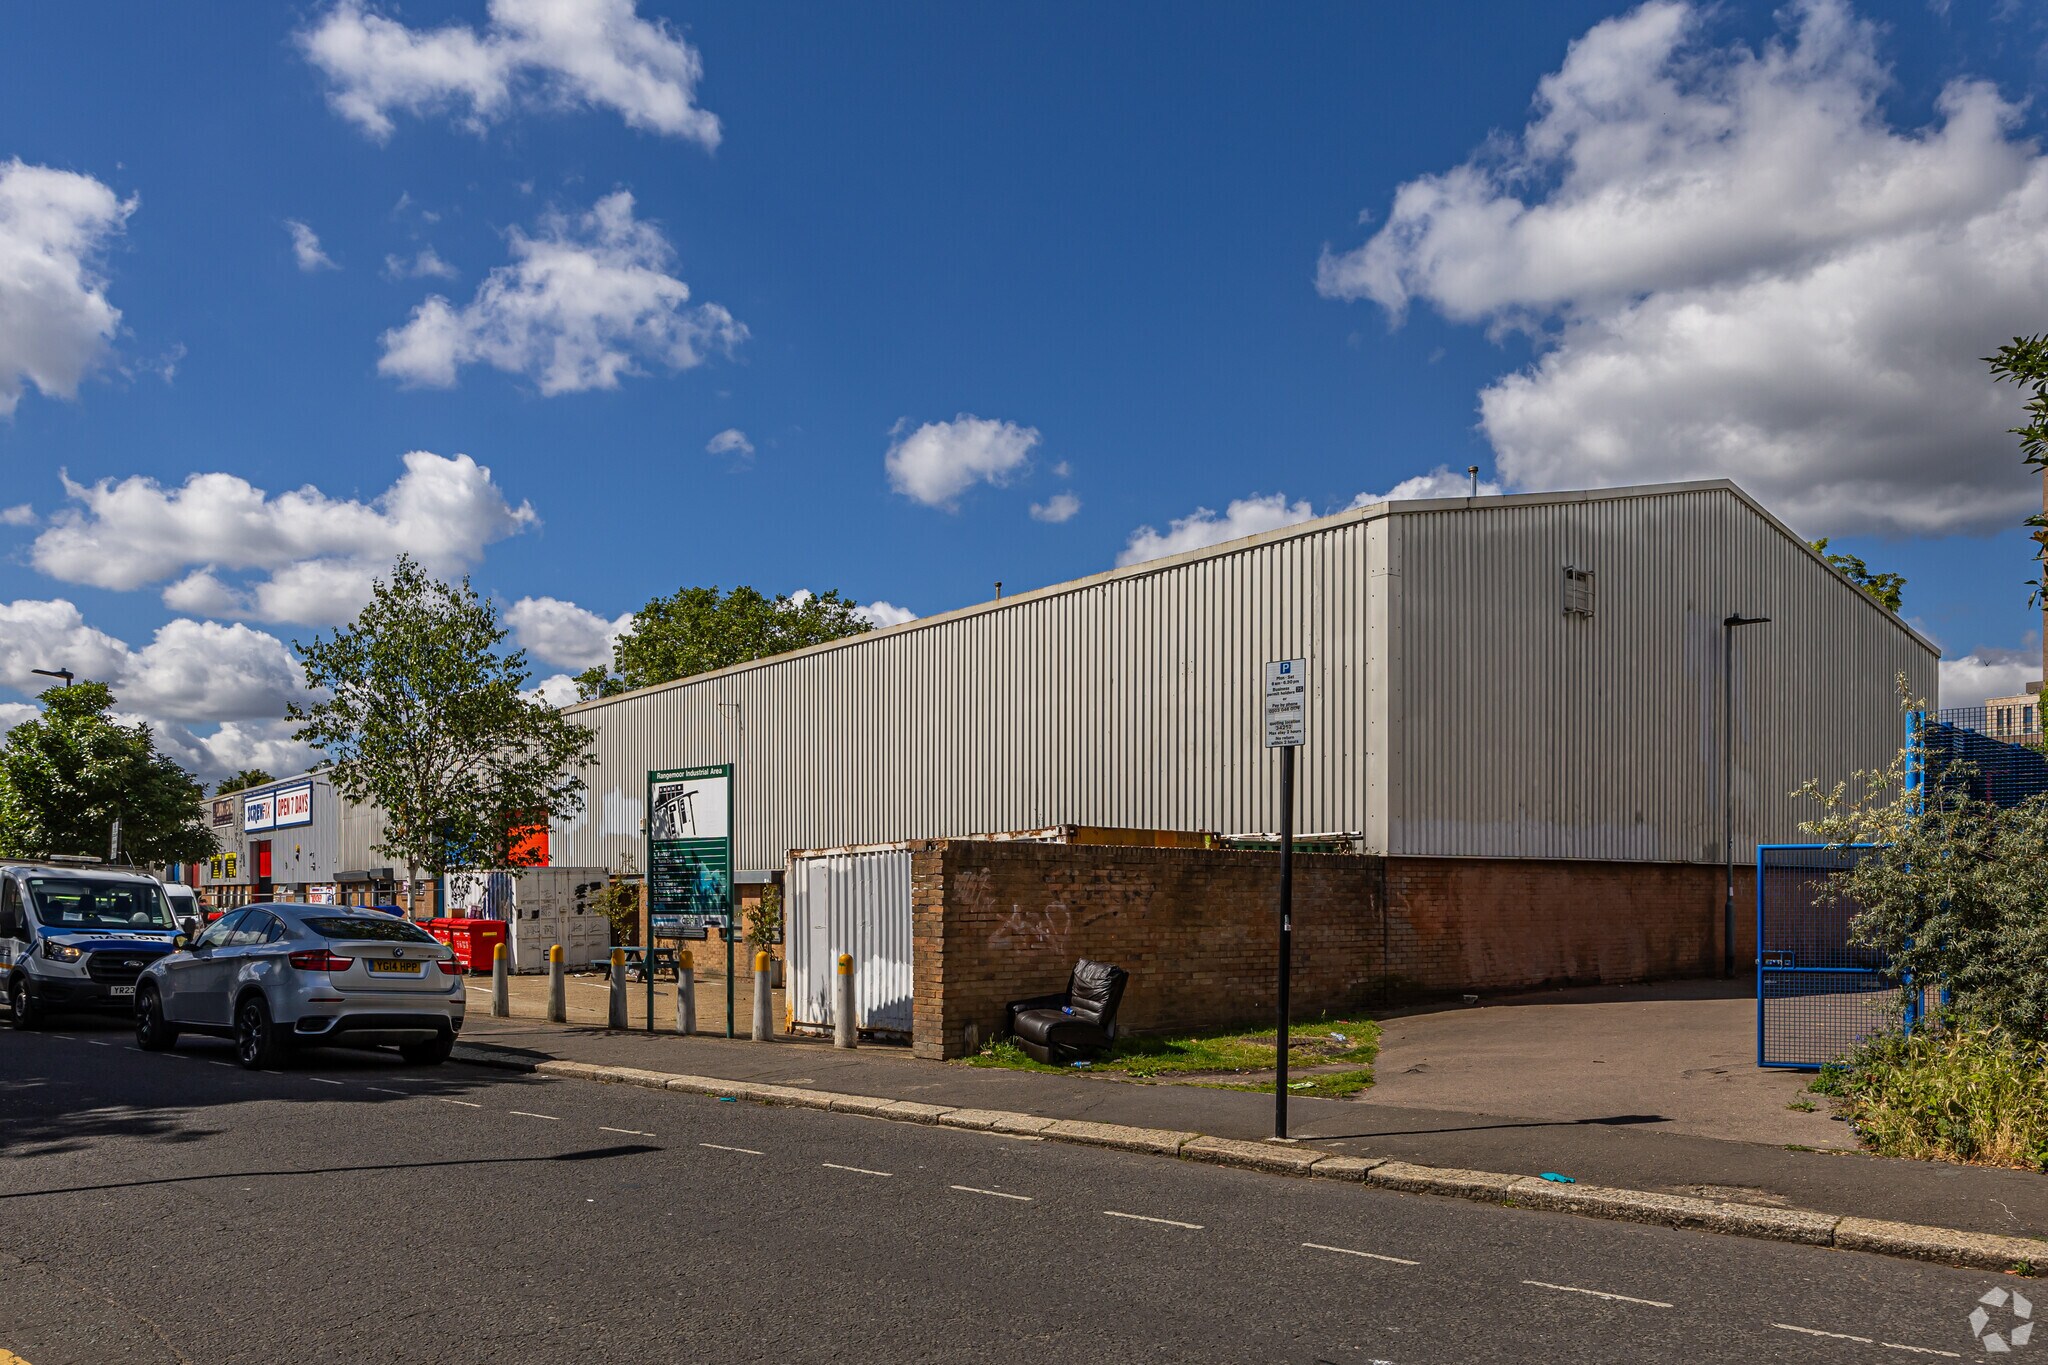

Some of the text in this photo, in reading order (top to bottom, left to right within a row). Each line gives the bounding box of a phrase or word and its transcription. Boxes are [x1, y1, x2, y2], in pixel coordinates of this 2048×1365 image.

[656, 767, 723, 780] Rangemoor Industrial Area
[277, 793, 309, 817] OPEN 7 DAYS
[376, 961, 418, 971] YG14 HPP
